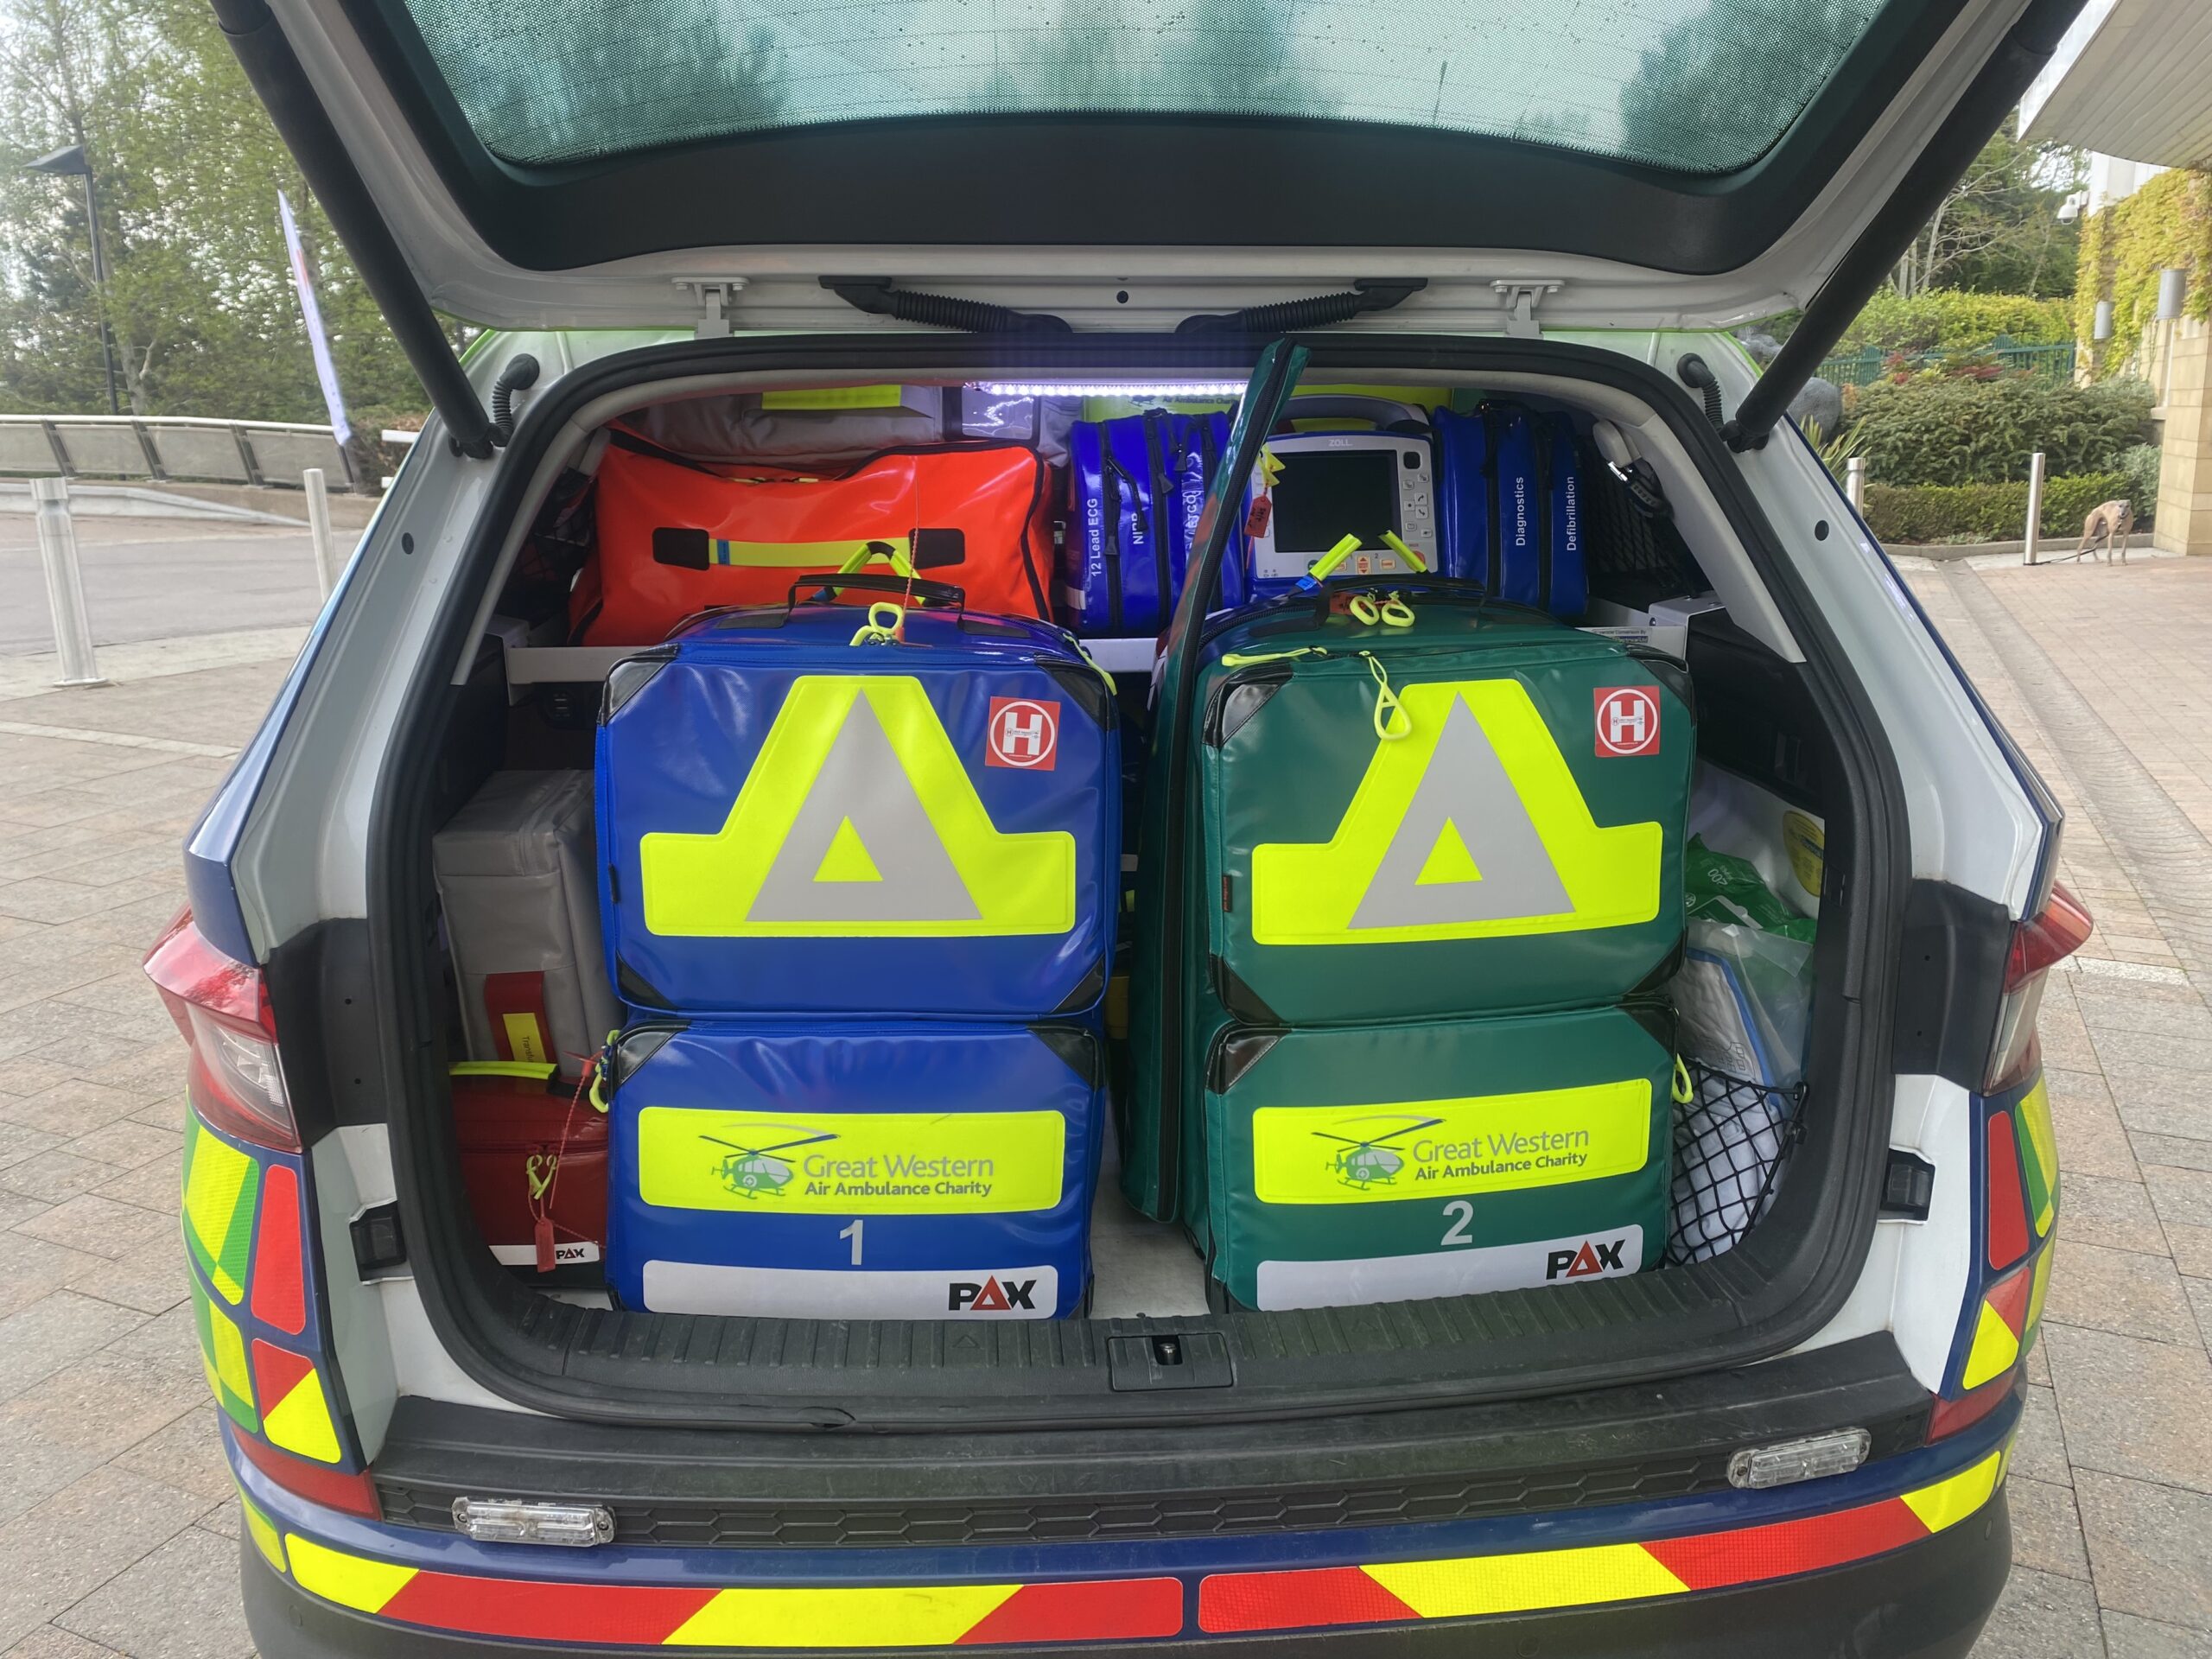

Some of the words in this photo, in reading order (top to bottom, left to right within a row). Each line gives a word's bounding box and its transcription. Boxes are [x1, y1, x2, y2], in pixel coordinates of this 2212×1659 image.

[1327, 438, 1353, 447] ZOLL
[1086, 498, 1099, 526] ECG
[1514, 476, 1528, 546] Diagnostics
[1565, 476, 1577, 551] Defibrillation
[1088, 529, 1102, 559] Lead
[1090, 563, 1102, 577] 12
[1002, 712, 1043, 756] H
[1610, 700, 1645, 743] H
[1413, 1138, 1483, 1164] Great
[1487, 1129, 1589, 1157] Western
[804, 1154, 878, 1178] Great
[883, 1154, 994, 1178] Western
[1414, 1167, 1439, 1181] Air
[1442, 1160, 1532, 1179] Ambulance
[1535, 1153, 1588, 1169] Charity
[804, 1182, 830, 1196] Air
[835, 1181, 930, 1196] Ambulance
[935, 1181, 993, 1198] Charity
[1440, 1200, 1474, 1245] 2
[556, 1248, 585, 1259] PAX
[840, 1219, 863, 1266] 1
[1546, 1239, 1625, 1280] PAX
[949, 1274, 1037, 1311] PAX
